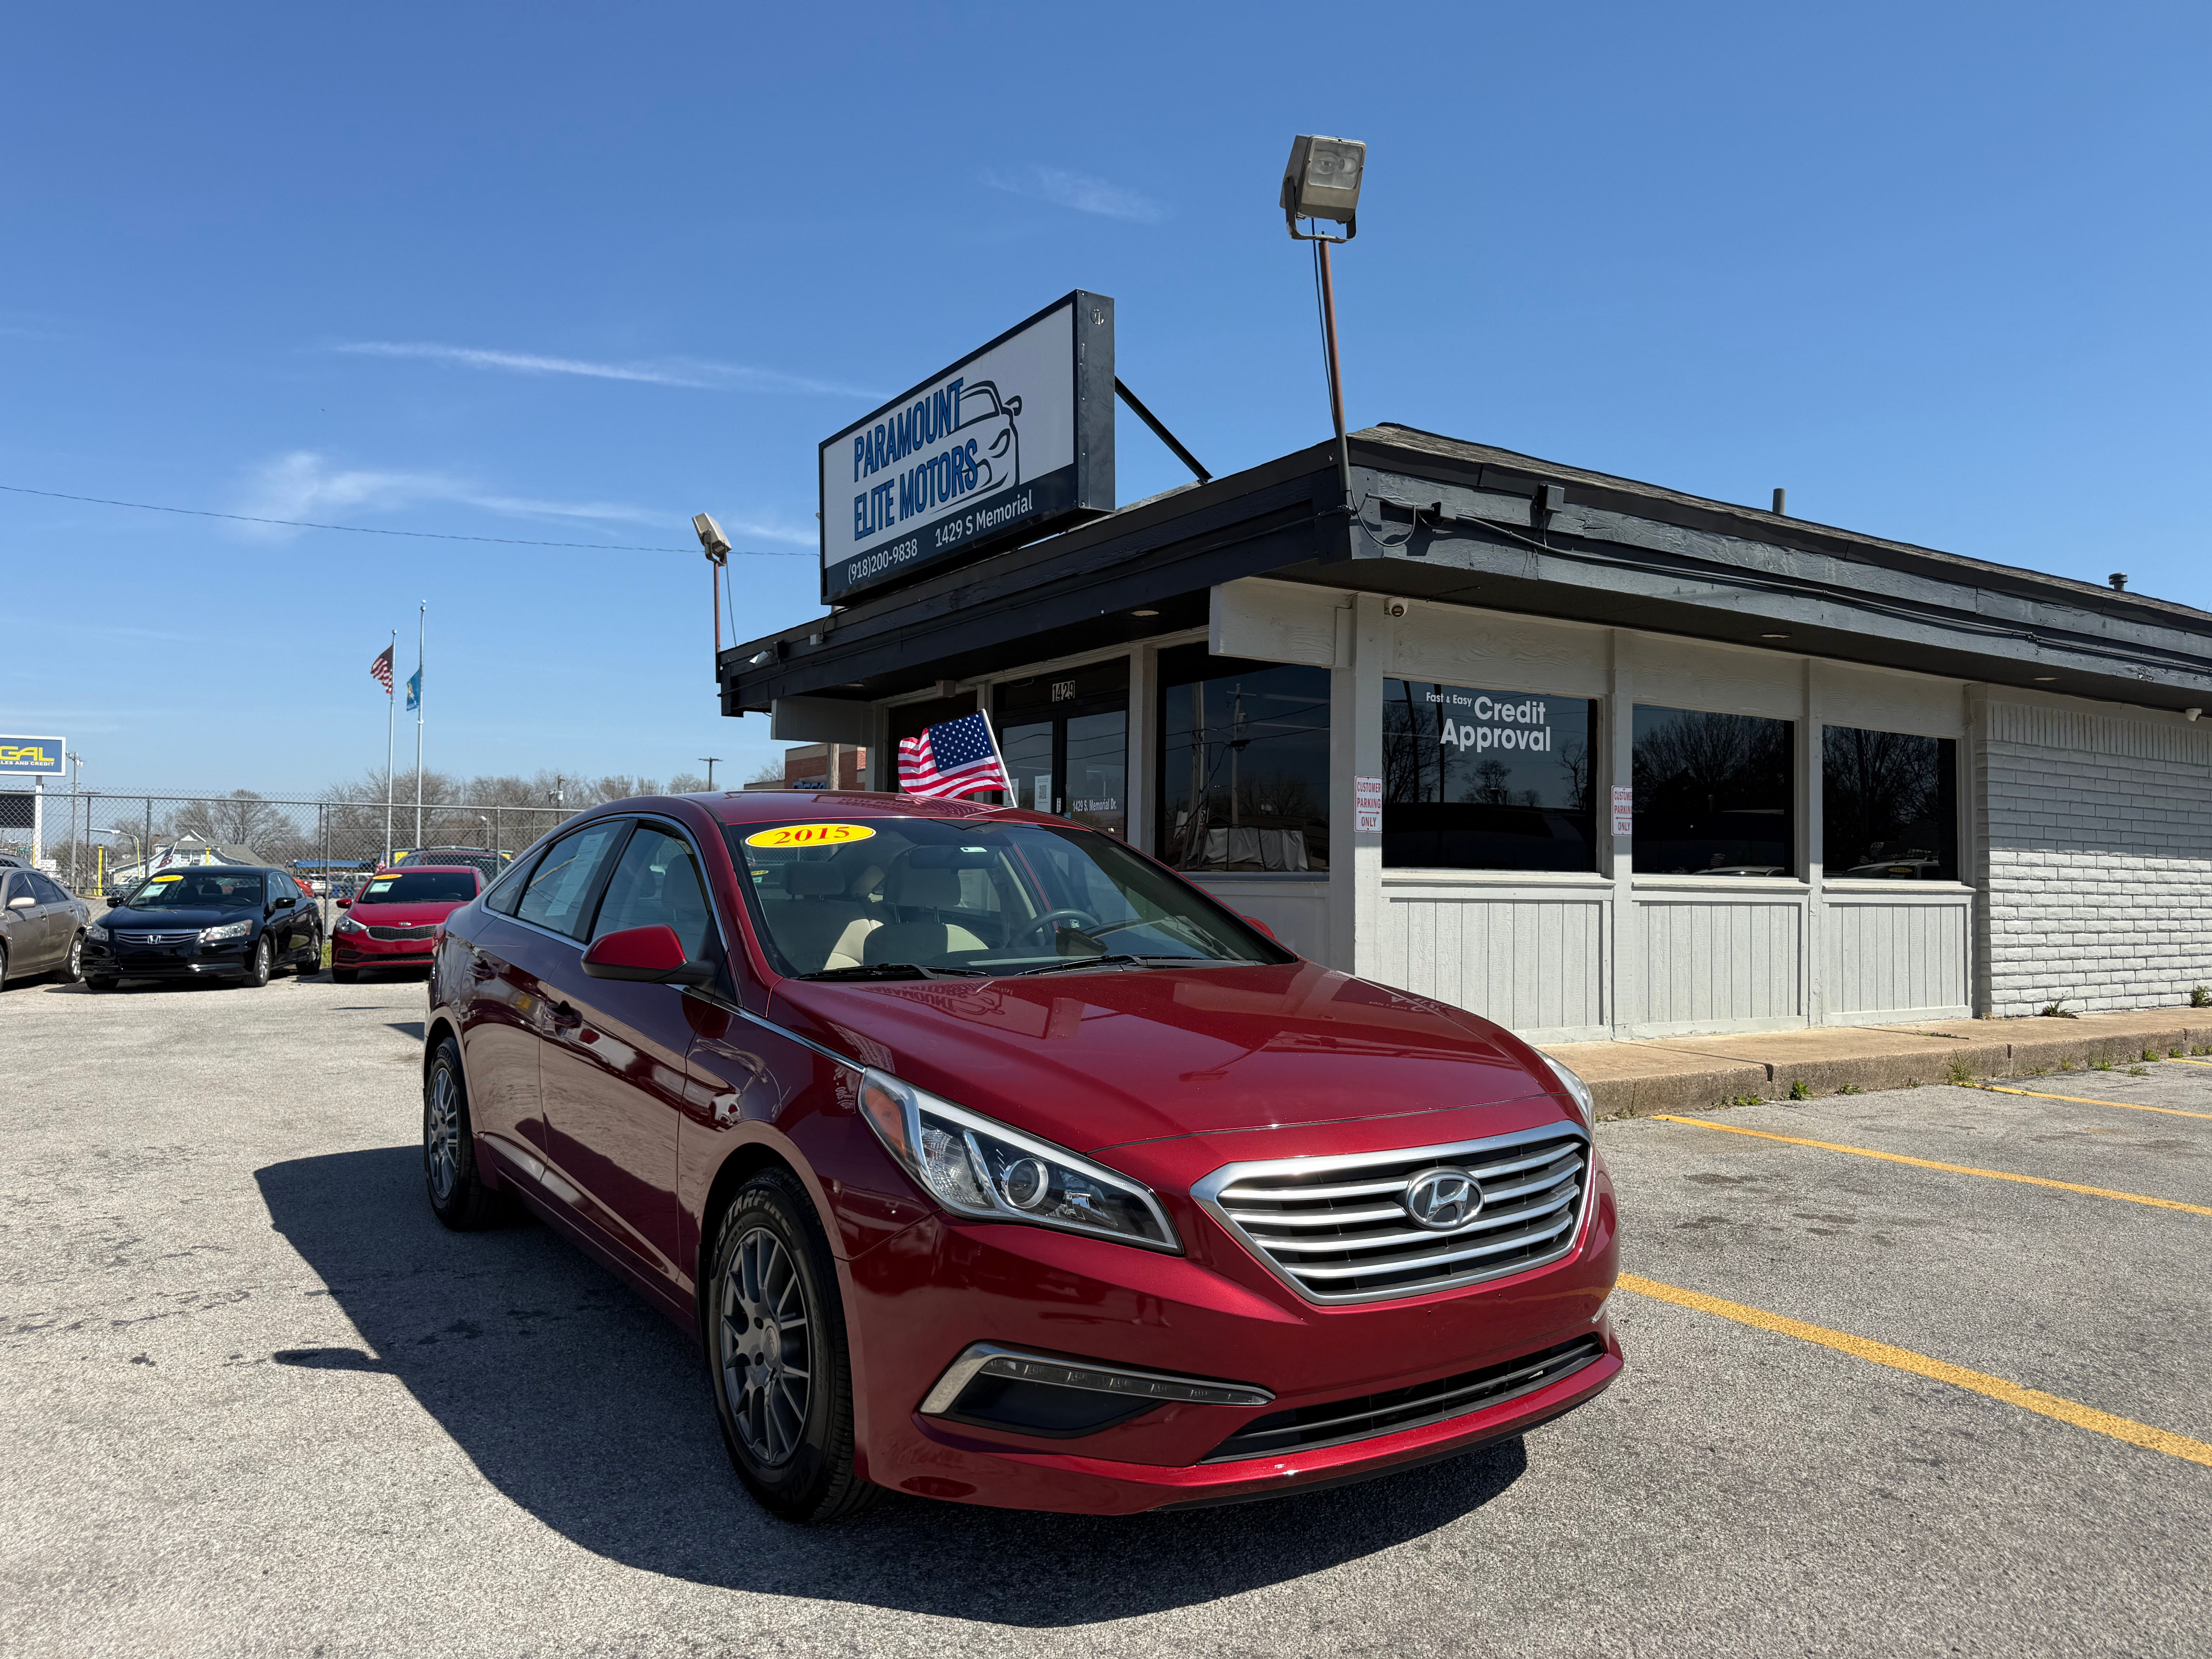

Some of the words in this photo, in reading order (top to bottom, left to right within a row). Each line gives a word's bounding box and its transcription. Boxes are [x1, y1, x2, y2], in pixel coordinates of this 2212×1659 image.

[854, 376, 964, 483] PARAMOUNT
[854, 478, 895, 541] ELITE
[900, 438, 978, 522] MOTORS
[848, 539, 918, 584] (918)200-9838
[935, 519, 963, 548] 1429
[965, 515, 973, 536] S
[976, 489, 1033, 531] Memorial
[1053, 681, 1075, 702] 1429
[1426, 692, 1444, 703] Fast
[1453, 694, 1472, 707] Easy
[1474, 696, 1546, 725] Credit
[1440, 718, 1550, 753] Approval
[1357, 781, 1381, 793] CUSTOMER
[1614, 791, 1632, 801] CUSTOME
[1073, 800, 1083, 812] 1429
[1084, 800, 1089, 812] S.
[1089, 798, 1109, 811] Memorial
[1357, 797, 1381, 809] PARKING
[1361, 816, 1377, 827] ONLY
[1618, 822, 1631, 831] ONLY
[774, 826, 850, 845] 2015
[718, 1189, 794, 1247] STARFIRE
